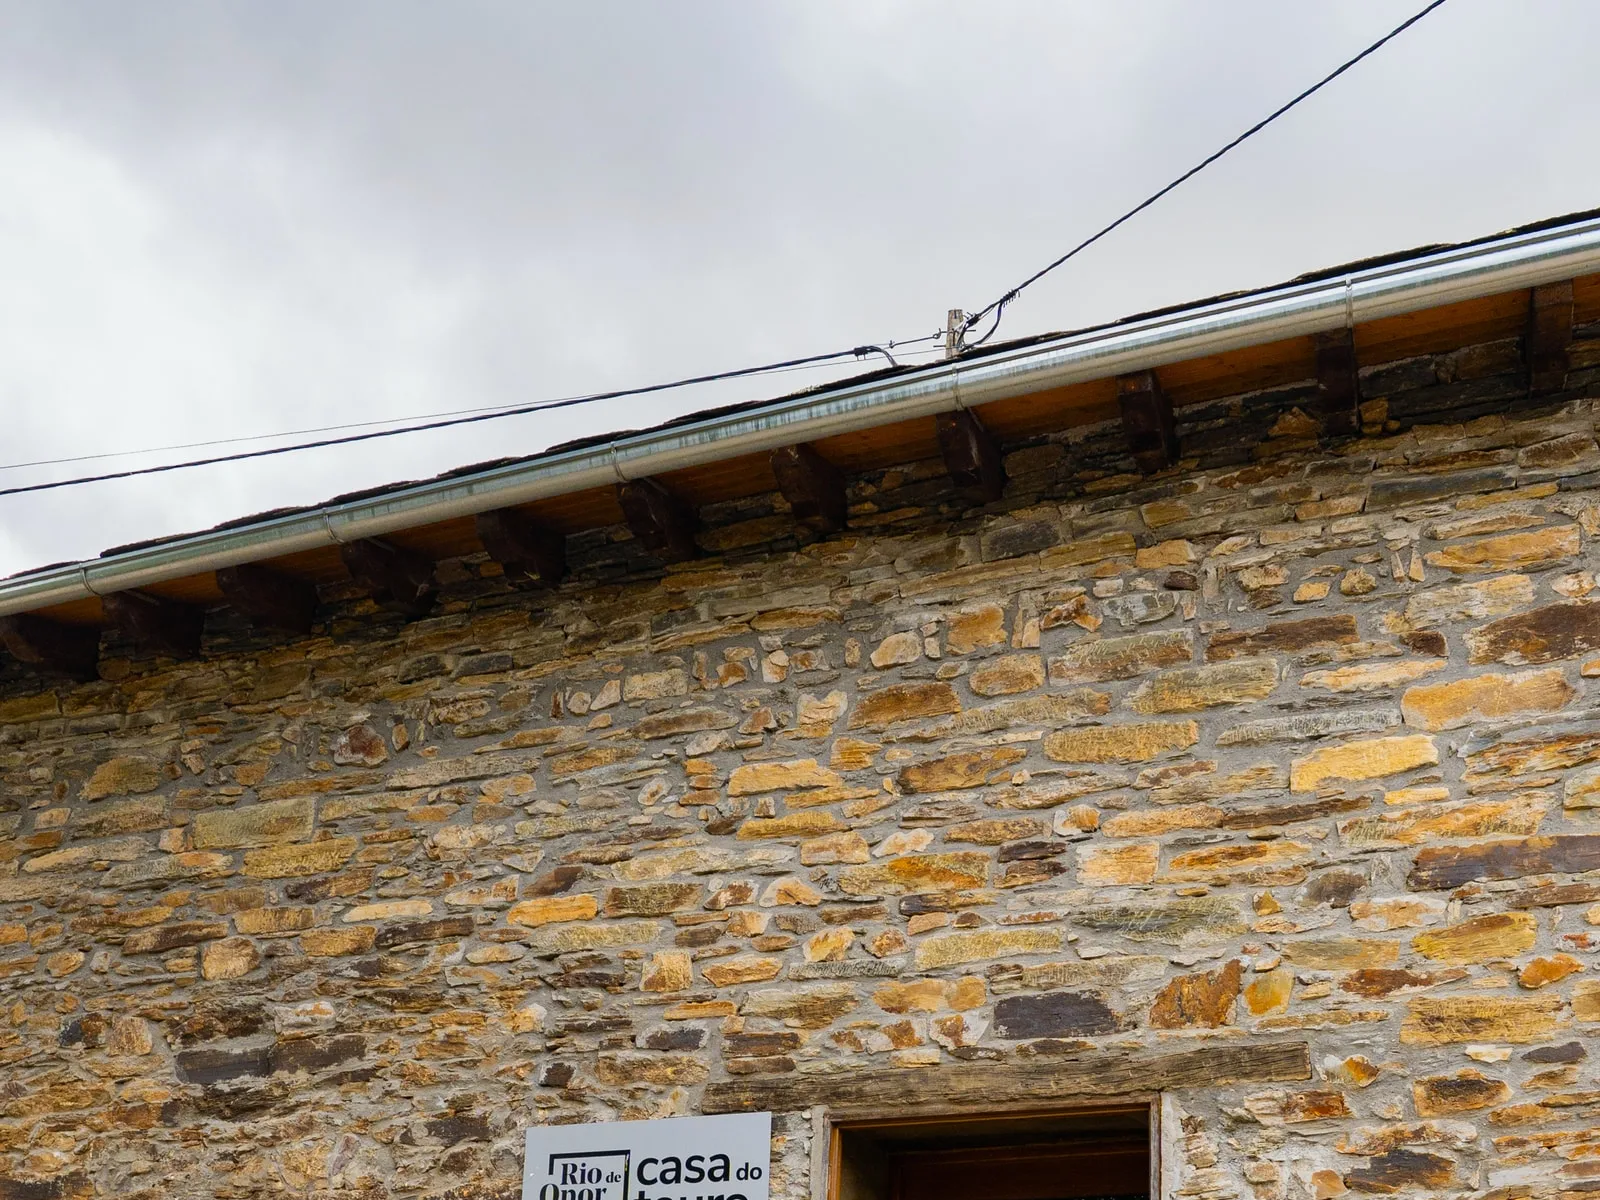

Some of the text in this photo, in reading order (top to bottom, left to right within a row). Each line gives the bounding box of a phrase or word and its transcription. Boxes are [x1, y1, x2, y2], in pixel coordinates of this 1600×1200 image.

[560, 1162, 622, 1186] Rio de
[636, 1153, 763, 1186] casa do
